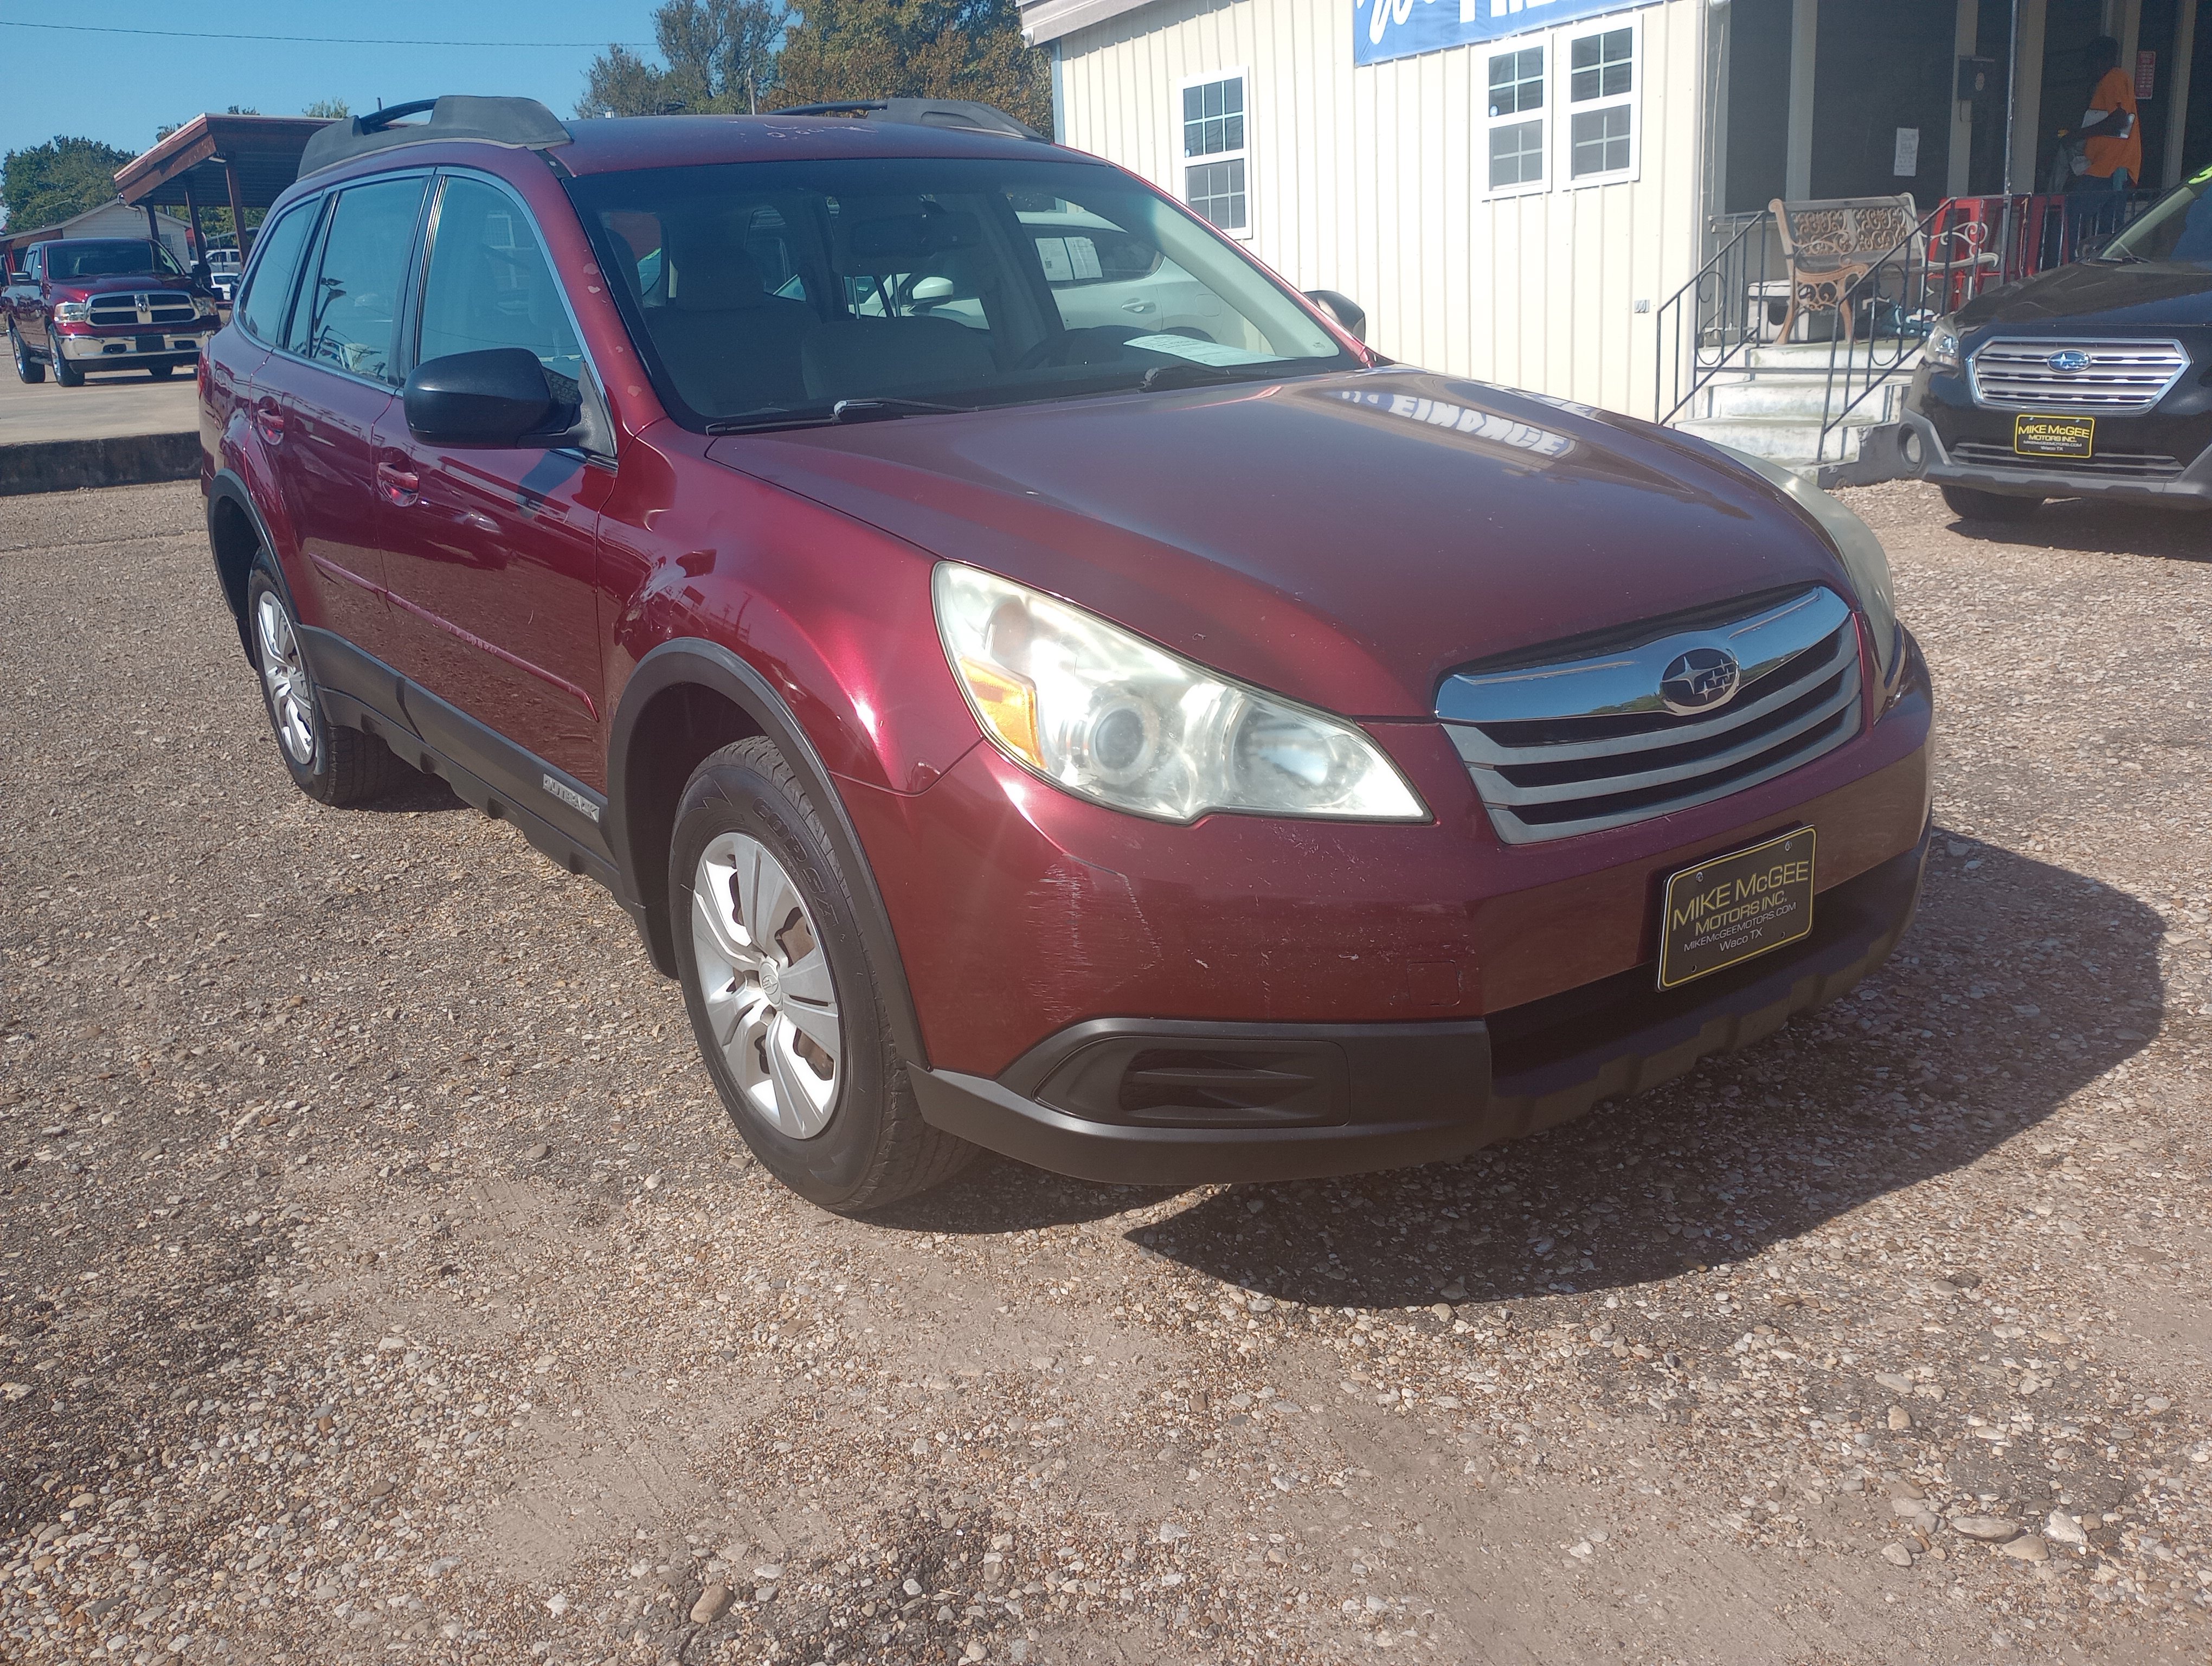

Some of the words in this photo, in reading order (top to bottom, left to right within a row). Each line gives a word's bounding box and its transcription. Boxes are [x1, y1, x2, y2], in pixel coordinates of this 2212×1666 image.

[2018, 425, 2047, 435] MIKE
[2048, 425, 2090, 438] McGEE
[1672, 881, 1732, 932] MIKE
[1735, 860, 1810, 902] McGEE
[1695, 901, 1760, 937] MOTORS
[1761, 890, 1787, 912] INC.
[1683, 902, 1797, 952] MIKEMcGEEMOTORS.COM
[1719, 935, 1748, 952] Waco
[1750, 927, 1763, 940] TX
